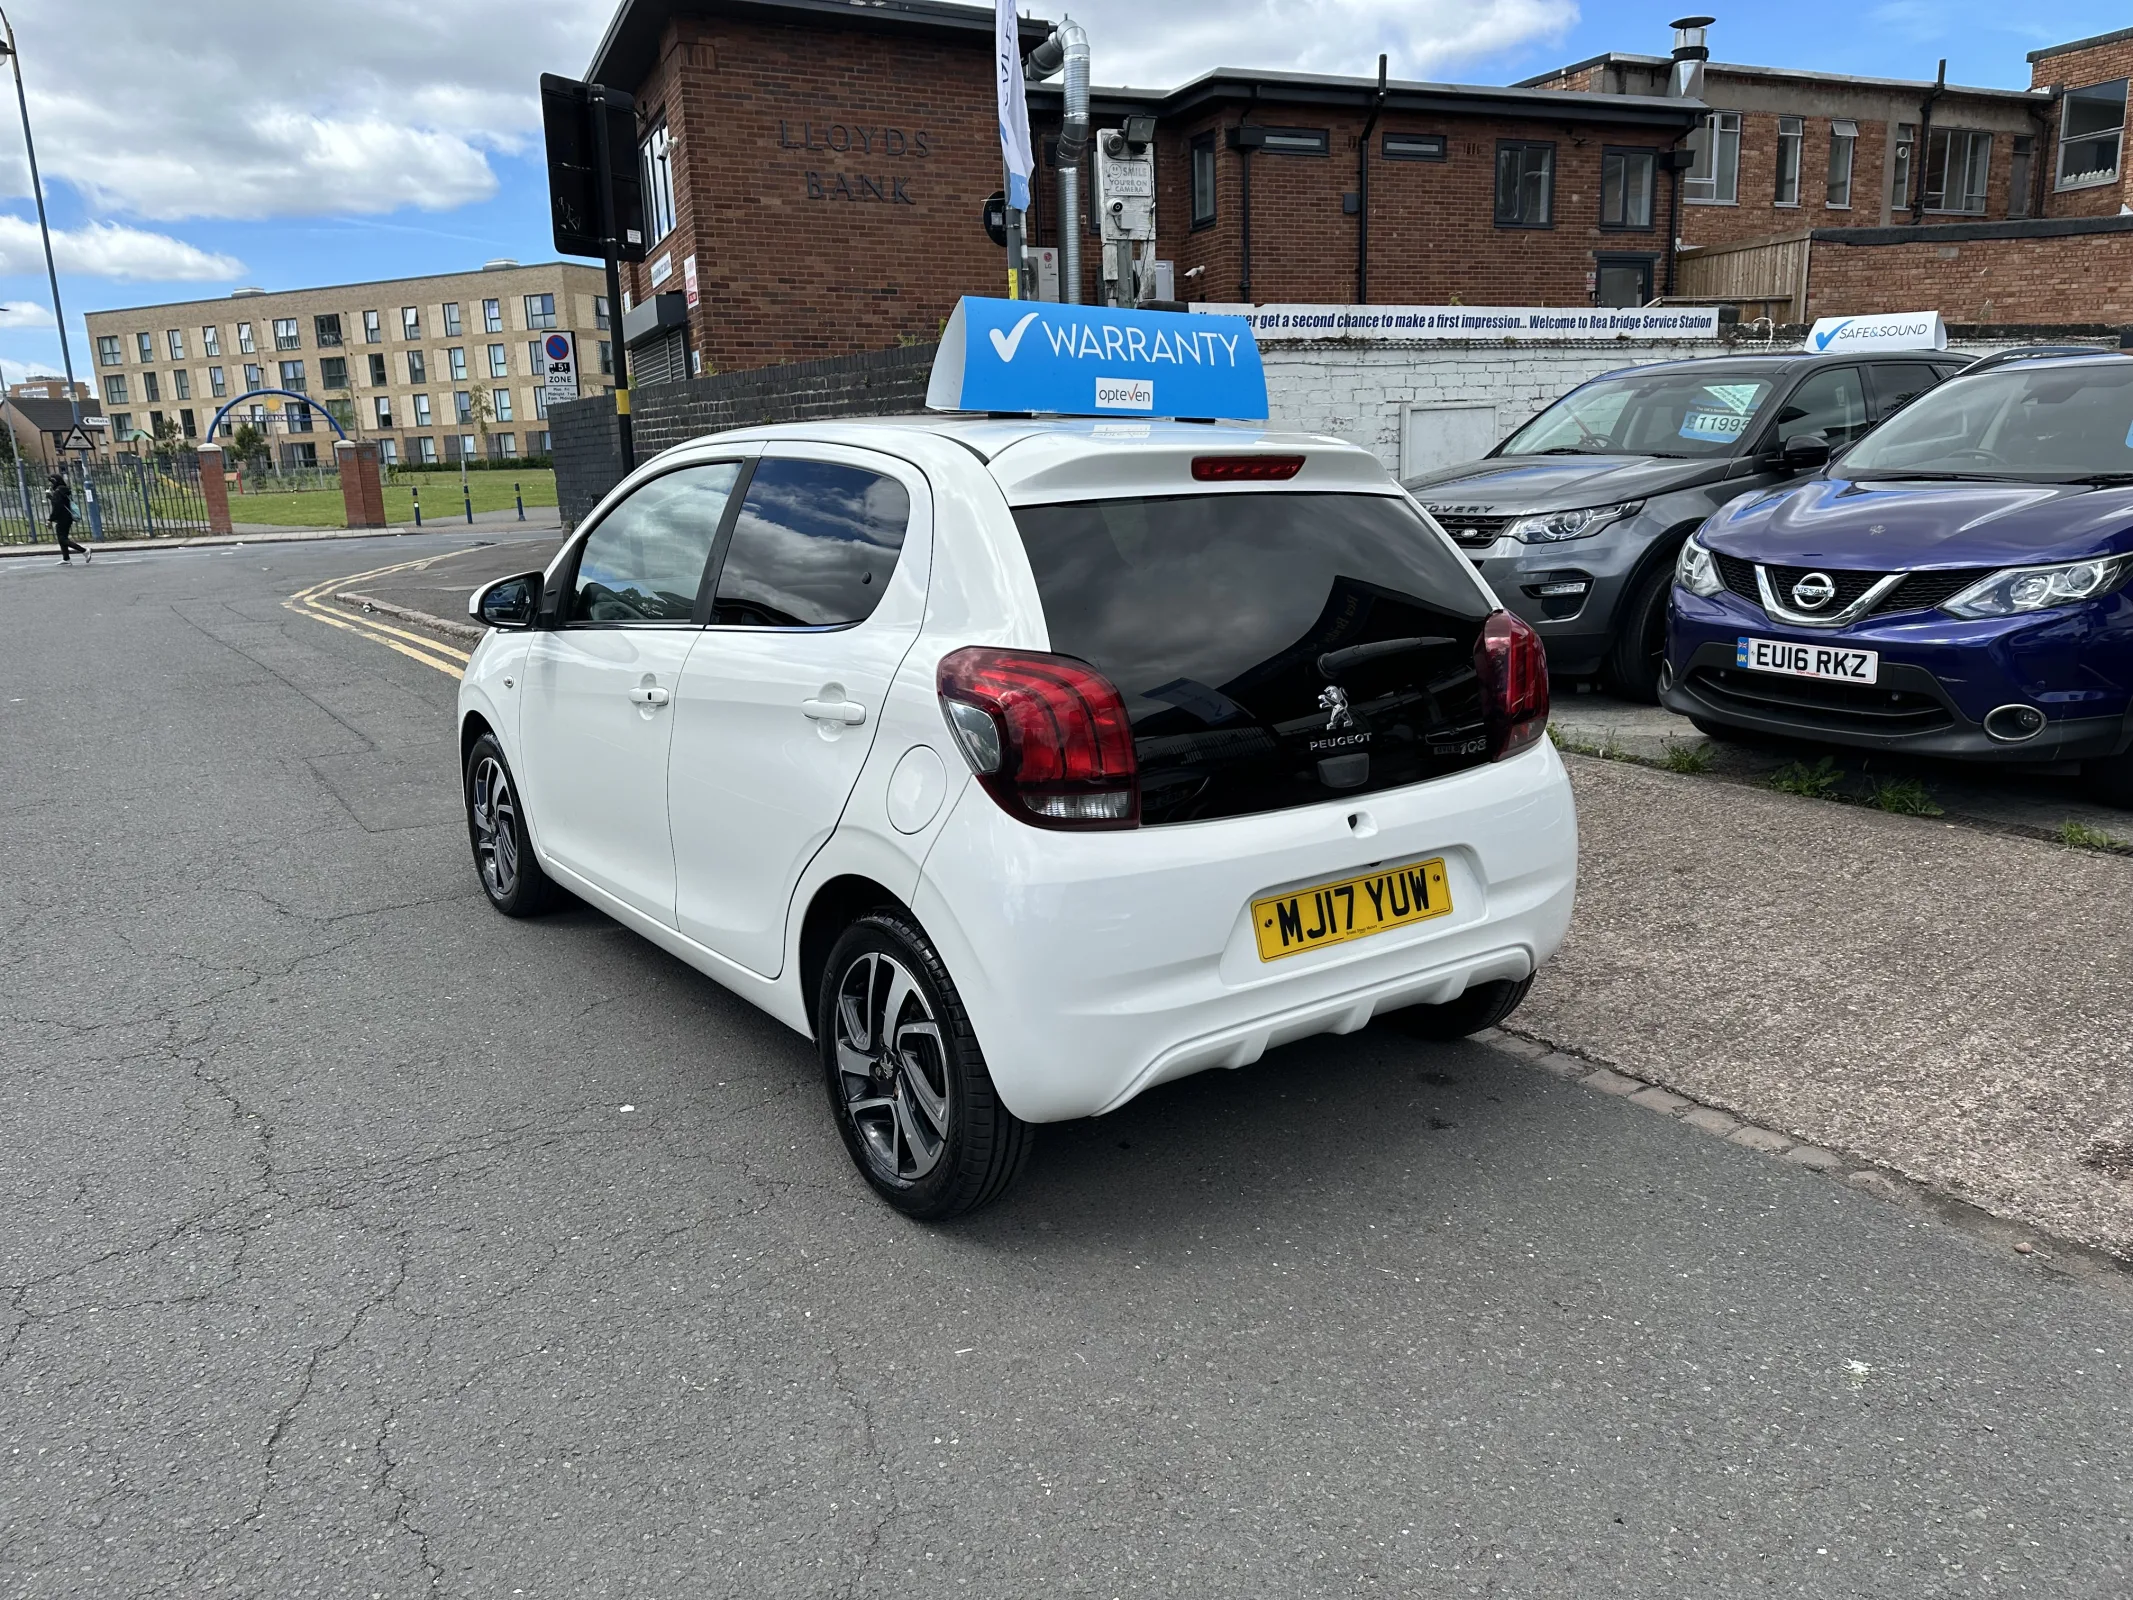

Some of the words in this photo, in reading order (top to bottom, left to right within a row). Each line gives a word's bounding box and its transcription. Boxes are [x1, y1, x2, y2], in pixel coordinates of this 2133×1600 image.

[779, 119, 930, 159] LLOYDS
[1122, 166, 1148, 178] SMILE
[805, 170, 917, 205] BANK
[1110, 179, 1136, 187] YOU'RE
[1114, 185, 1144, 193] CAMERA
[1259, 313, 1282, 329] get
[1282, 315, 1290, 328] a
[1292, 313, 1335, 328] second
[1337, 313, 1379, 328] chance
[1381, 314, 1393, 328] to
[1395, 313, 1426, 328] make
[1427, 316, 1435, 328] a
[1436, 313, 1460, 329] first
[1529, 314, 1576, 329] Welcome
[1577, 315, 1589, 329] to
[1589, 315, 1608, 329] Rea
[1609, 315, 1642, 330] Bridge
[1642, 315, 1678, 329] Service
[1679, 315, 1712, 329] Station
[1838, 323, 1928, 340] SAFE&SOUND
[1041, 320, 1239, 367] WARRANTY
[549, 375, 572, 383] ZONE
[1099, 383, 1151, 404] opteven
[1424, 504, 1495, 514] OVERY
[1794, 586, 1830, 596] NISSAN
[1736, 653, 1747, 663] UK
[1756, 642, 1809, 672] EU16
[1816, 650, 1868, 679] RKZ
[1309, 732, 1373, 751] PEUGEOT
[1459, 738, 1487, 755] 108
[1276, 884, 1355, 947] MJ17
[1364, 867, 1430, 922] YUW
